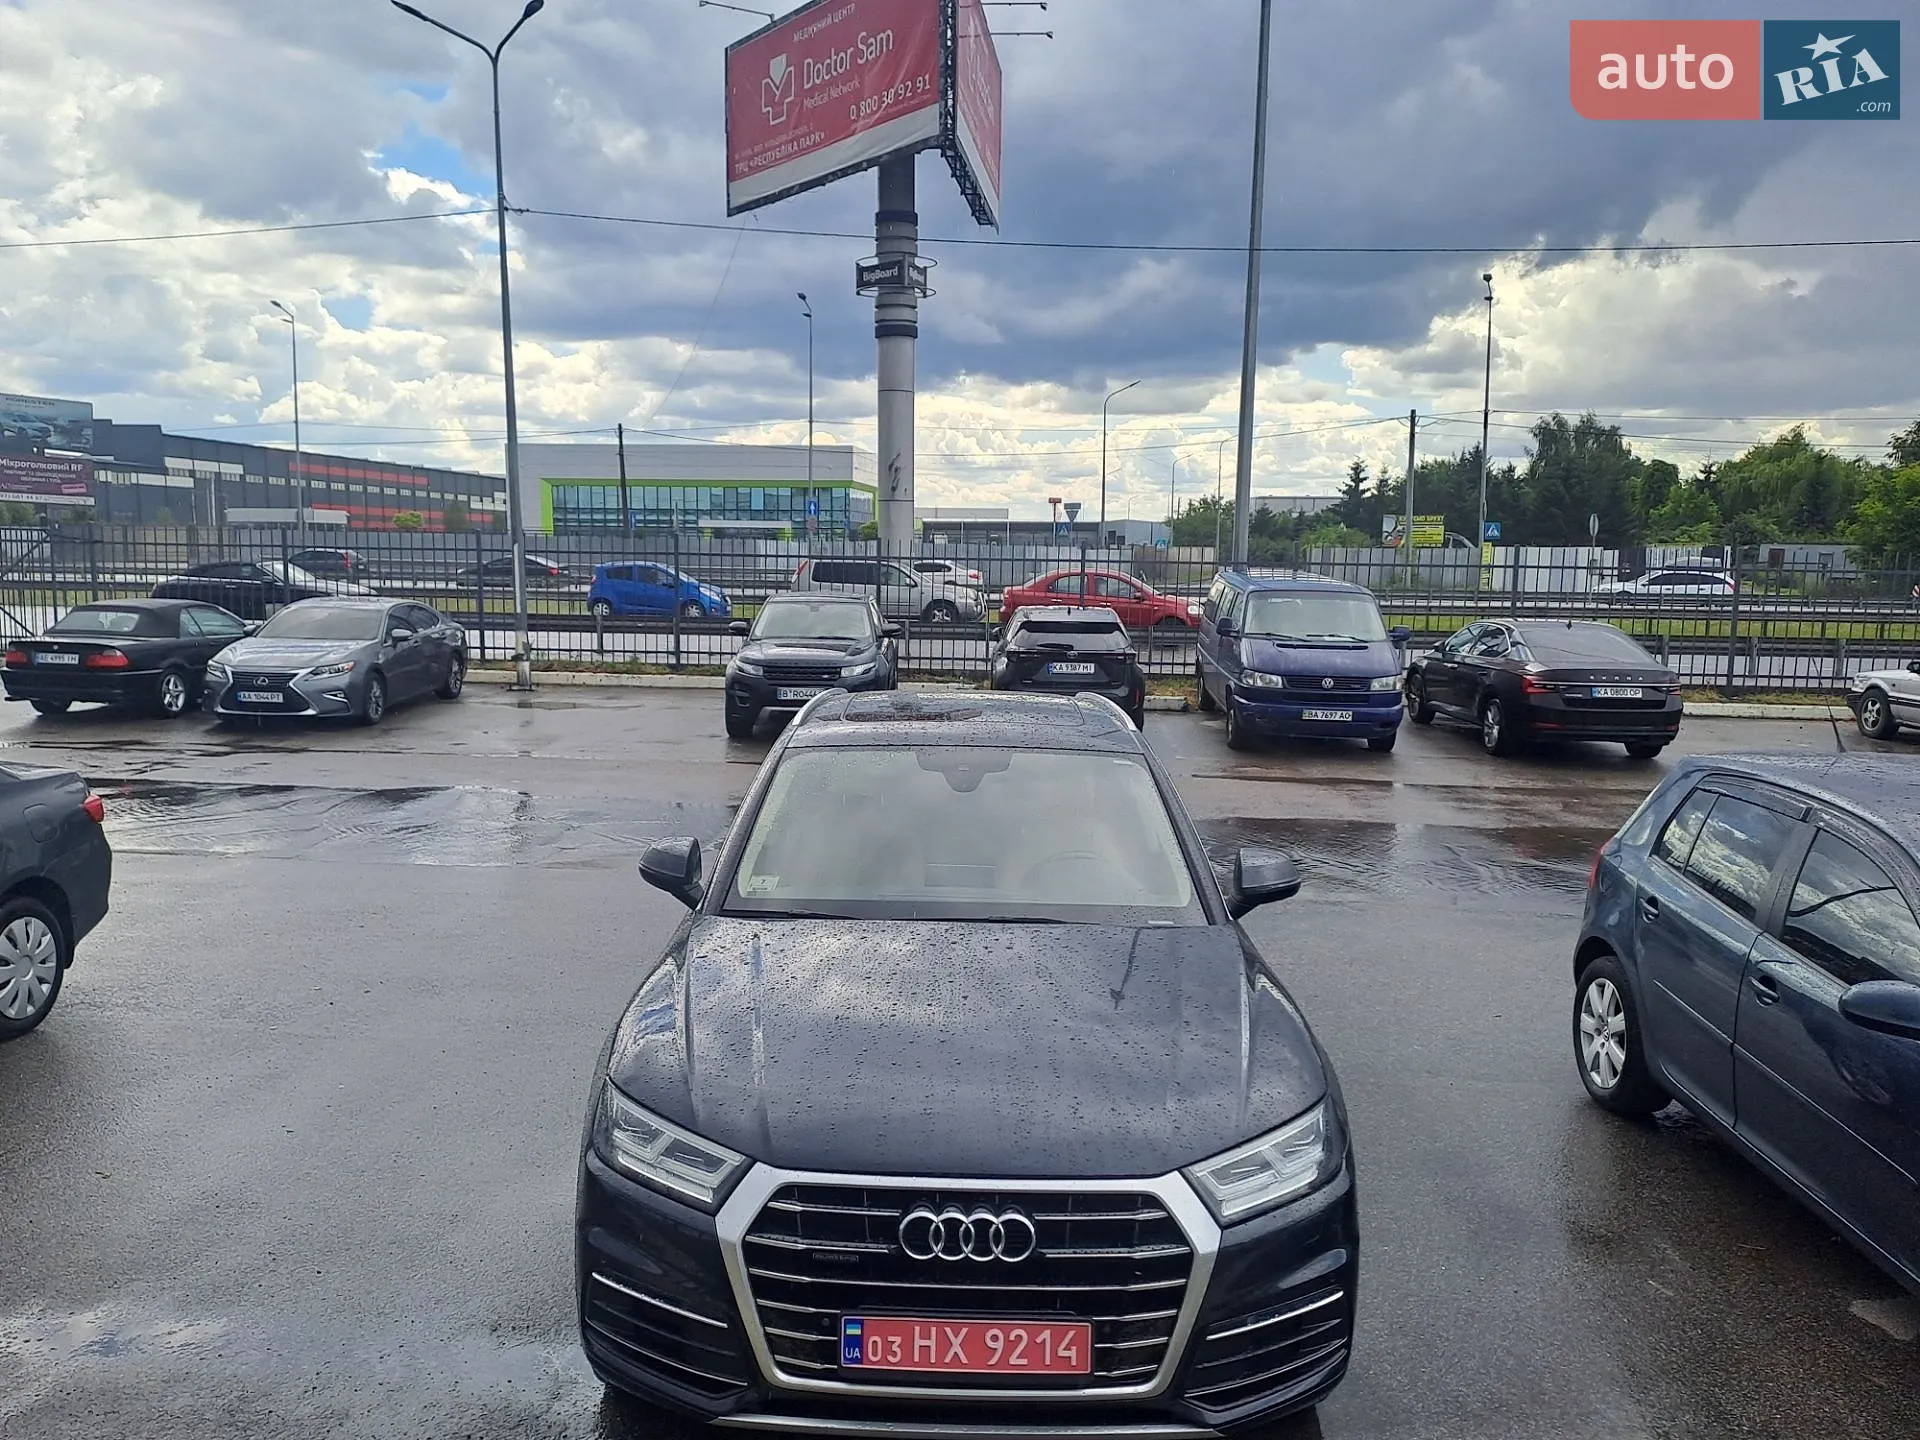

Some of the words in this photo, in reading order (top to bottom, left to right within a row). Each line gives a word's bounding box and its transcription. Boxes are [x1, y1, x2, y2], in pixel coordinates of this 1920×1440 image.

[804, 47, 854, 89] Doctor
[857, 29, 893, 64] Sam
[860, 95, 878, 116] 800
[898, 81, 912, 100] 92
[916, 74, 930, 93] 91
[863, 266, 898, 282] BigBoard
[845, 1347, 861, 1360] UA
[867, 1335, 902, 1363] 03
[913, 1325, 969, 1364] HX
[984, 1328, 1077, 1366] 9214
